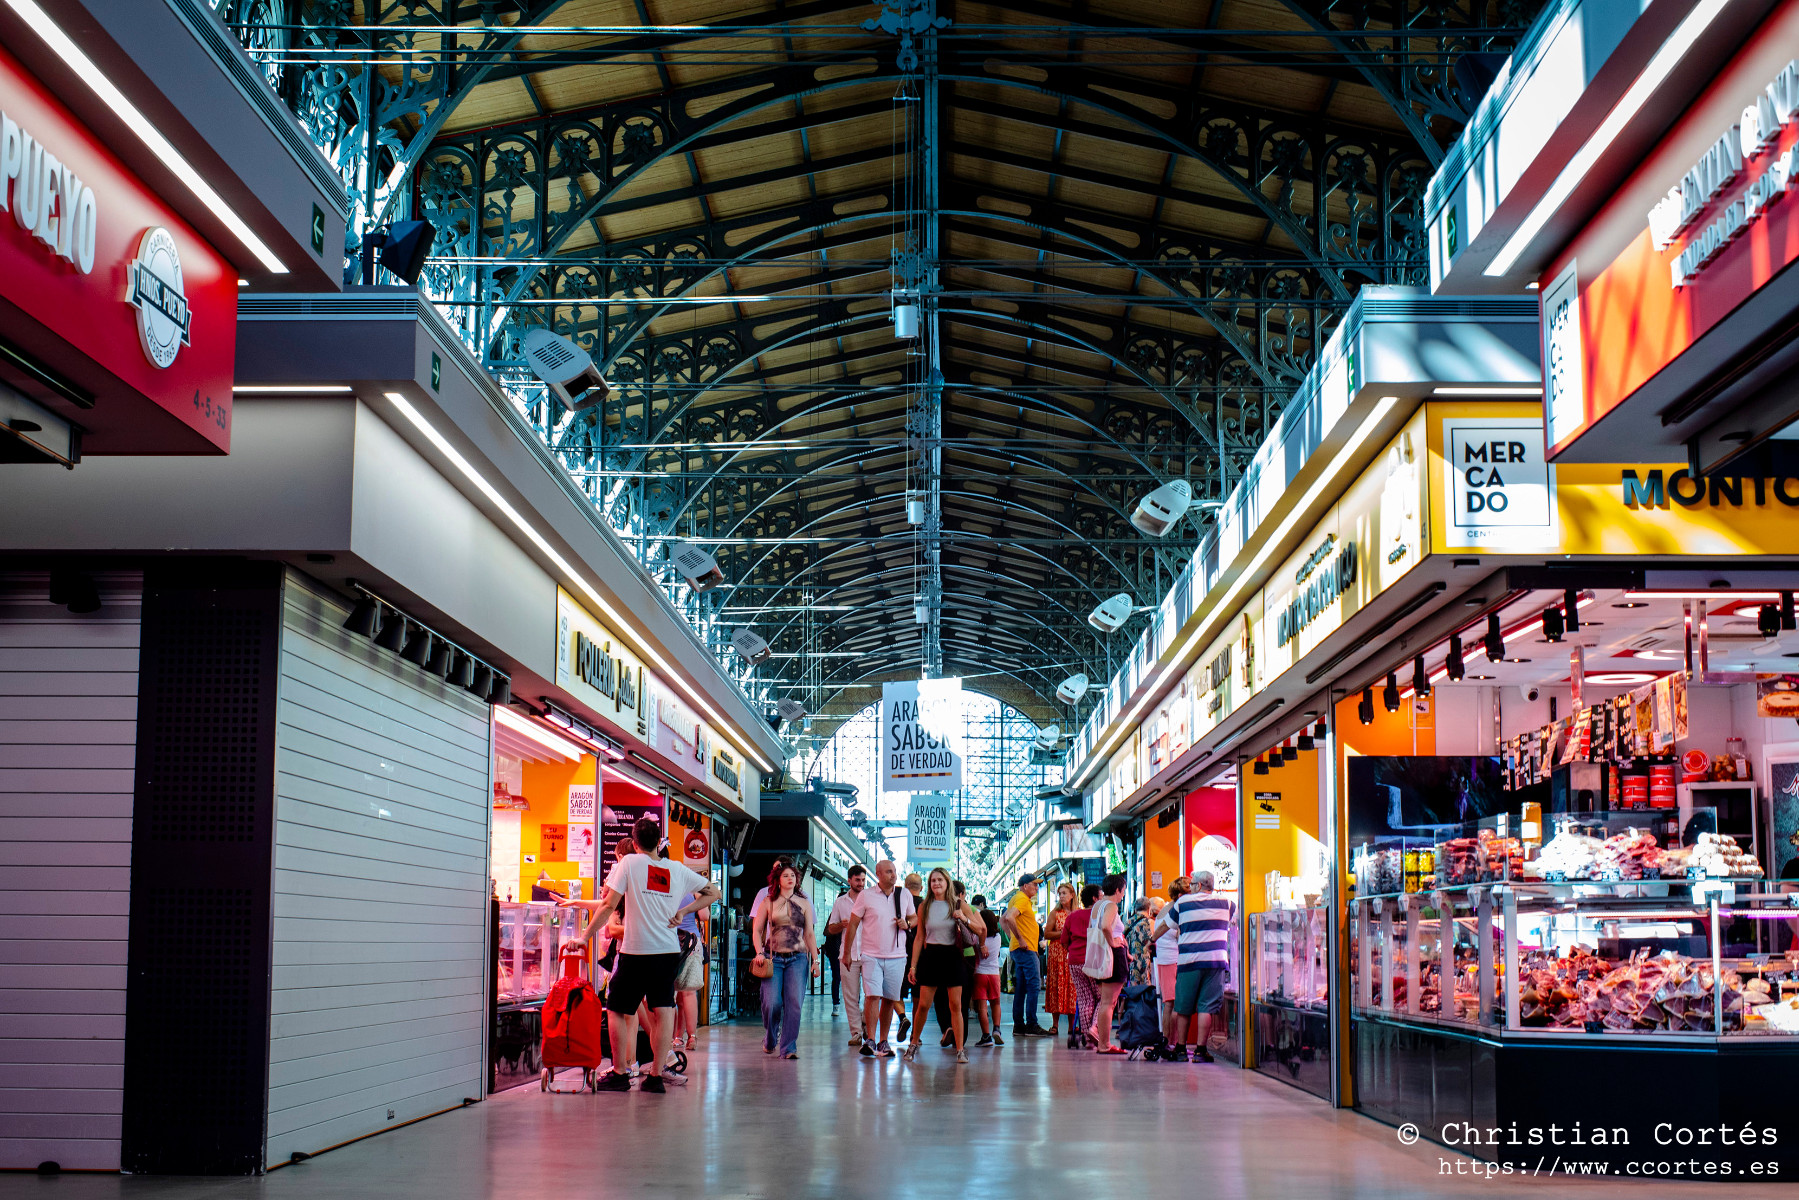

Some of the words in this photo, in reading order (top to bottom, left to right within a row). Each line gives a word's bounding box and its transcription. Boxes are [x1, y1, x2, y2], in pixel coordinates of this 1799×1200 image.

[0, 110, 97, 275] PUEYO
[162, 286, 186, 325] PUEYO
[147, 326, 162, 362] DESDE
[1464, 441, 1526, 463] MER
[1464, 466, 1505, 488] CA
[1466, 491, 1508, 513] DO
[891, 753, 905, 770] DE
[909, 751, 953, 769] VERDAD
[570, 799, 592, 808] SABOR
[571, 790, 593, 799] ARAGÓN
[914, 803, 946, 819] ARAGÓN
[914, 818, 946, 836] SABOR
[914, 835, 923, 846] DE
[923, 836, 946, 847] VERDAD
